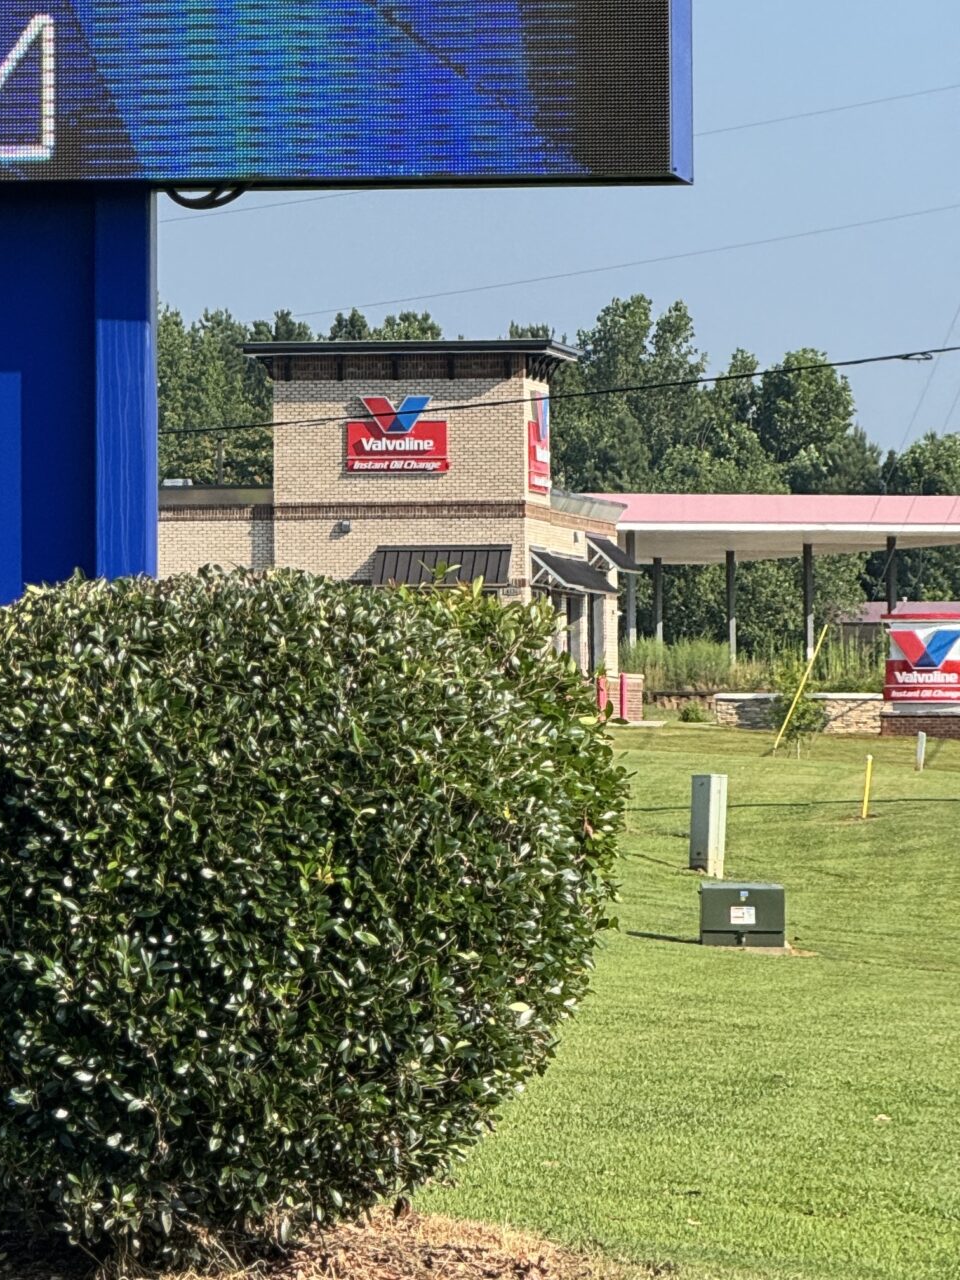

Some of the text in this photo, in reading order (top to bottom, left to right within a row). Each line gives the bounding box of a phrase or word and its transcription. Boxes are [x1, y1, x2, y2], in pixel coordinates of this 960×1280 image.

[361, 437, 434, 451] Valvoline
[353, 460, 442, 471] Instant Oil Change
[894, 671, 958, 683] Valvoline
